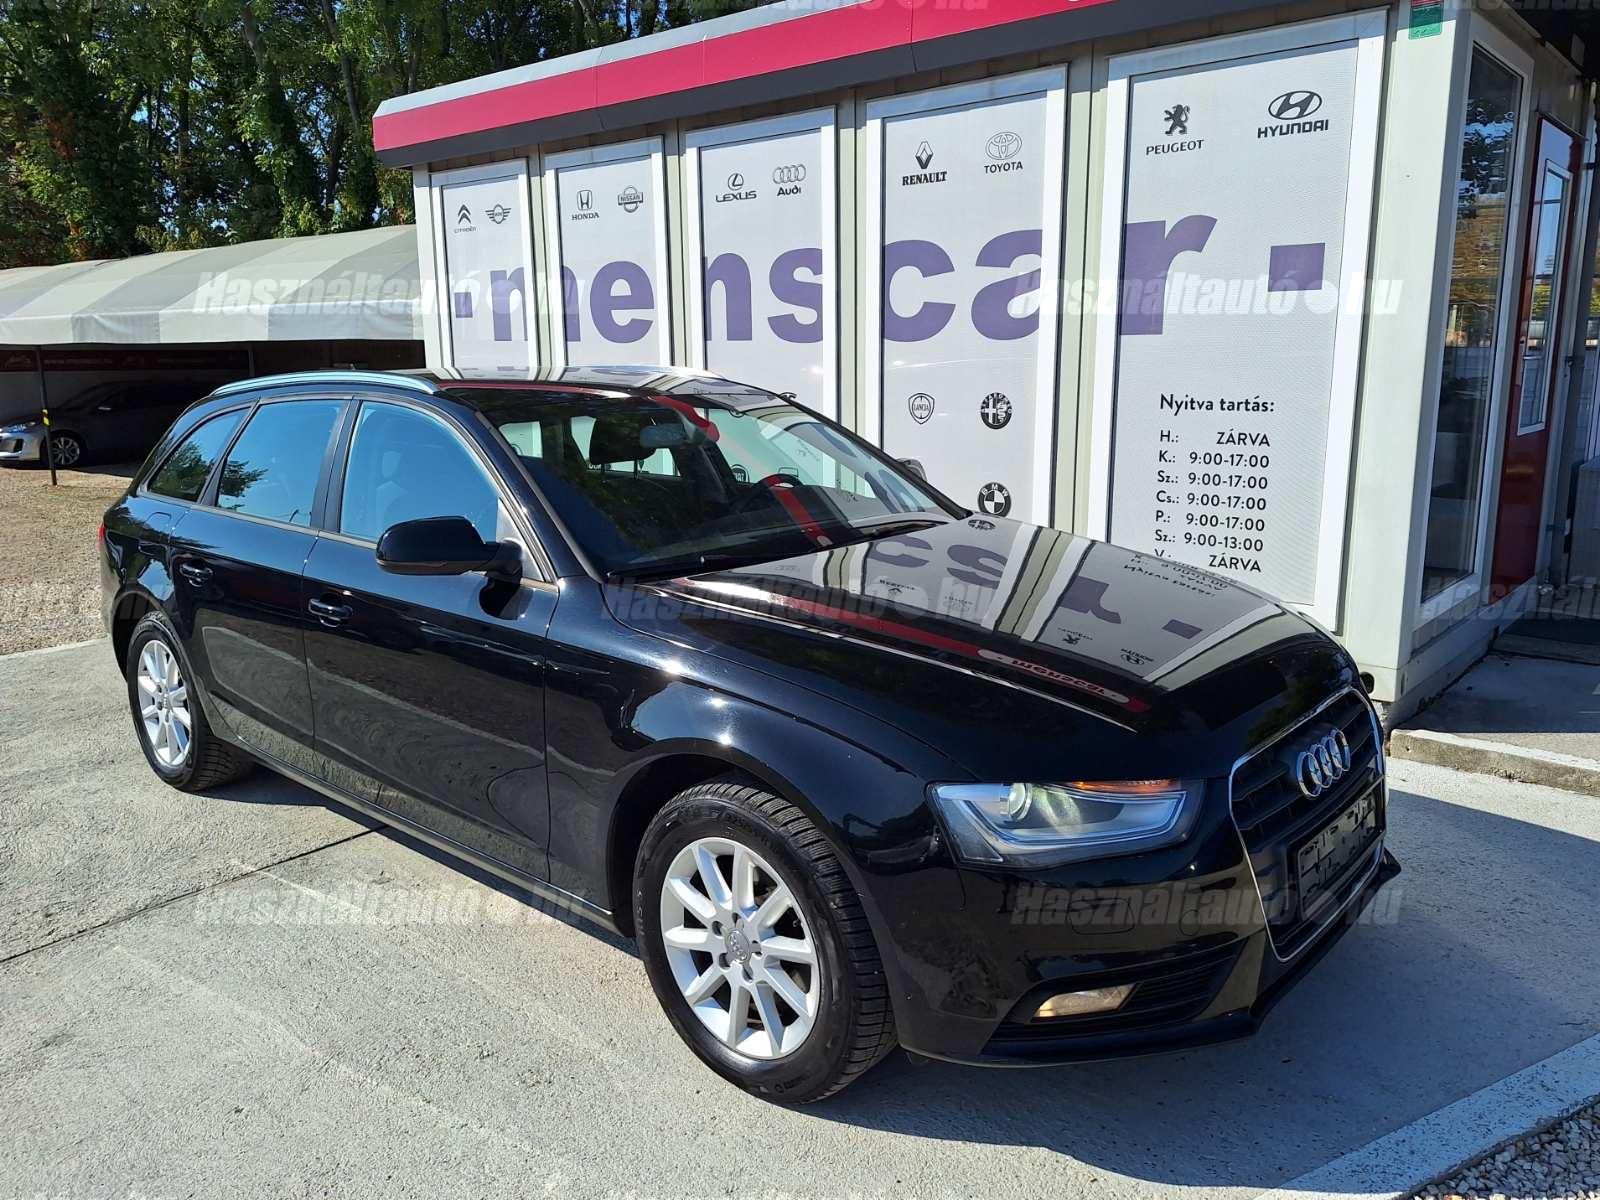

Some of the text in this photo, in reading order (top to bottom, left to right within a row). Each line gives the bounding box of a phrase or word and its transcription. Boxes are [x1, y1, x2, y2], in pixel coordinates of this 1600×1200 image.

[1257, 119, 1329, 138] HYUNDAI
[1146, 139, 1204, 155] PEUGEOT
[983, 160, 1023, 174] TOYOTA
[902, 172, 948, 186] RENAULT
[620, 193, 641, 202] NISSAN
[715, 190, 757, 203] LEXUS
[776, 185, 802, 197] Audi
[571, 211, 600, 221] HONDA
[1160, 393, 1275, 416] Nyitva tartás:
[1160, 428, 1270, 447] H.: ZÁRVA
[1158, 449, 1270, 468] K.: 9:00-17:00
[1157, 470, 1268, 489] Sz.: 9:00-17:00
[1156, 490, 1267, 510] Cs.: 9:00-17:00
[1155, 510, 1265, 531] P.: 9:00-17:00
[1154, 529, 1264, 551] Sz.: 9:00-13:00
[1208, 552, 1262, 572] ZÁRVA
